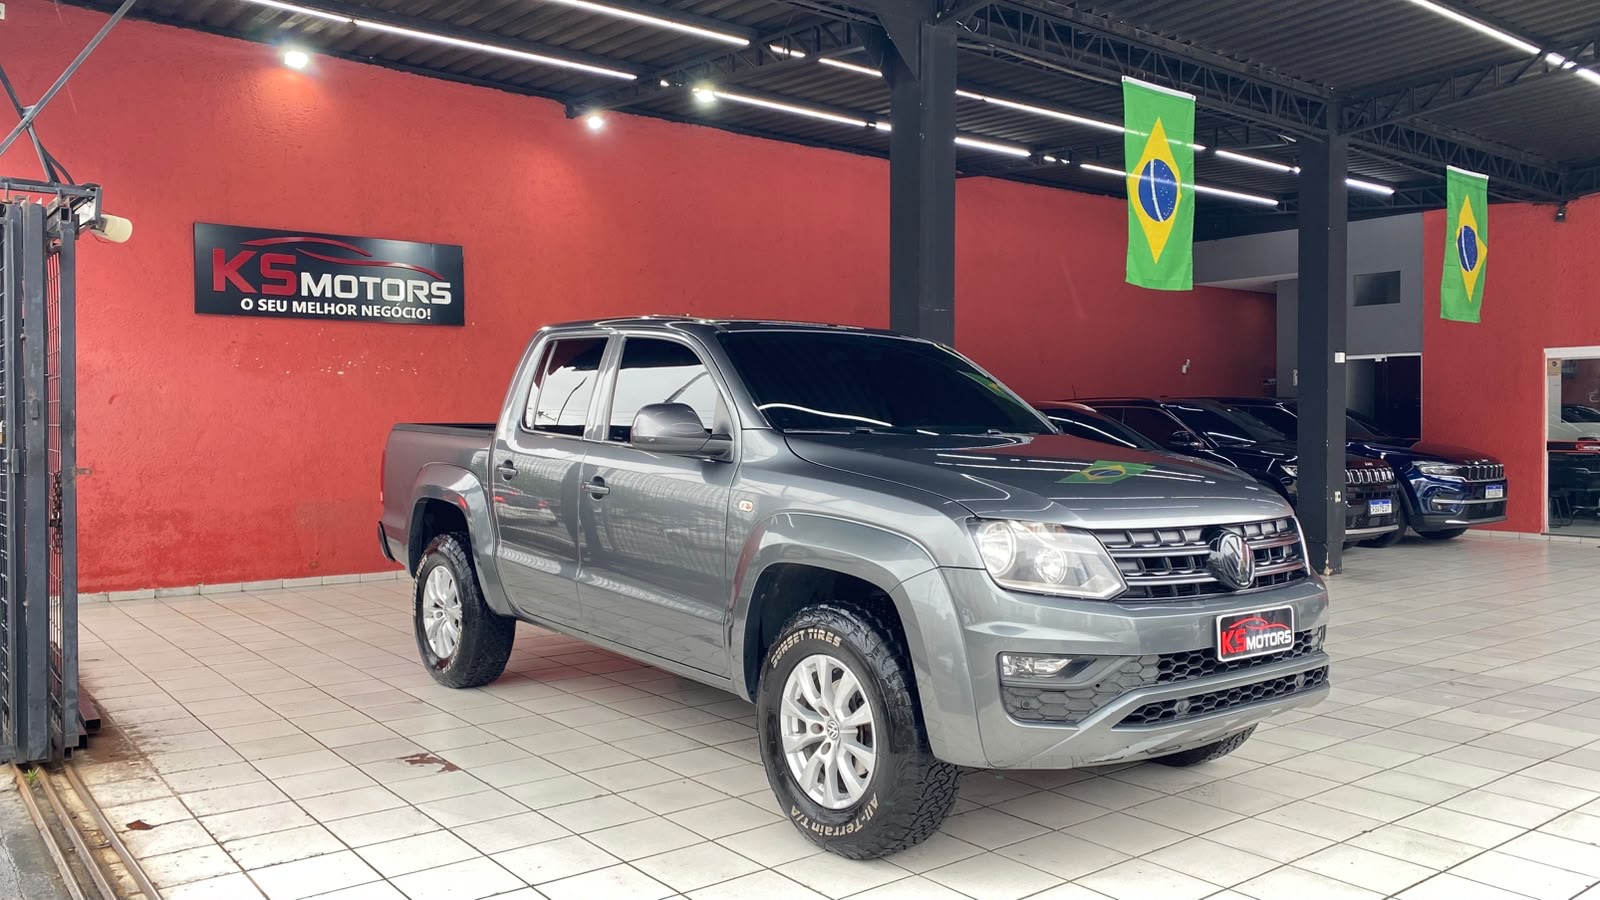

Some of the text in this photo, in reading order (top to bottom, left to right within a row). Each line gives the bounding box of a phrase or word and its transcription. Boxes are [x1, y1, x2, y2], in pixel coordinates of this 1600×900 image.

[240, 298, 431, 320] O SEU MELHOR NEGÓCIO!
[770, 628, 842, 669] SUNSET TIRES
[791, 792, 879, 836] All-Terrain T/A
